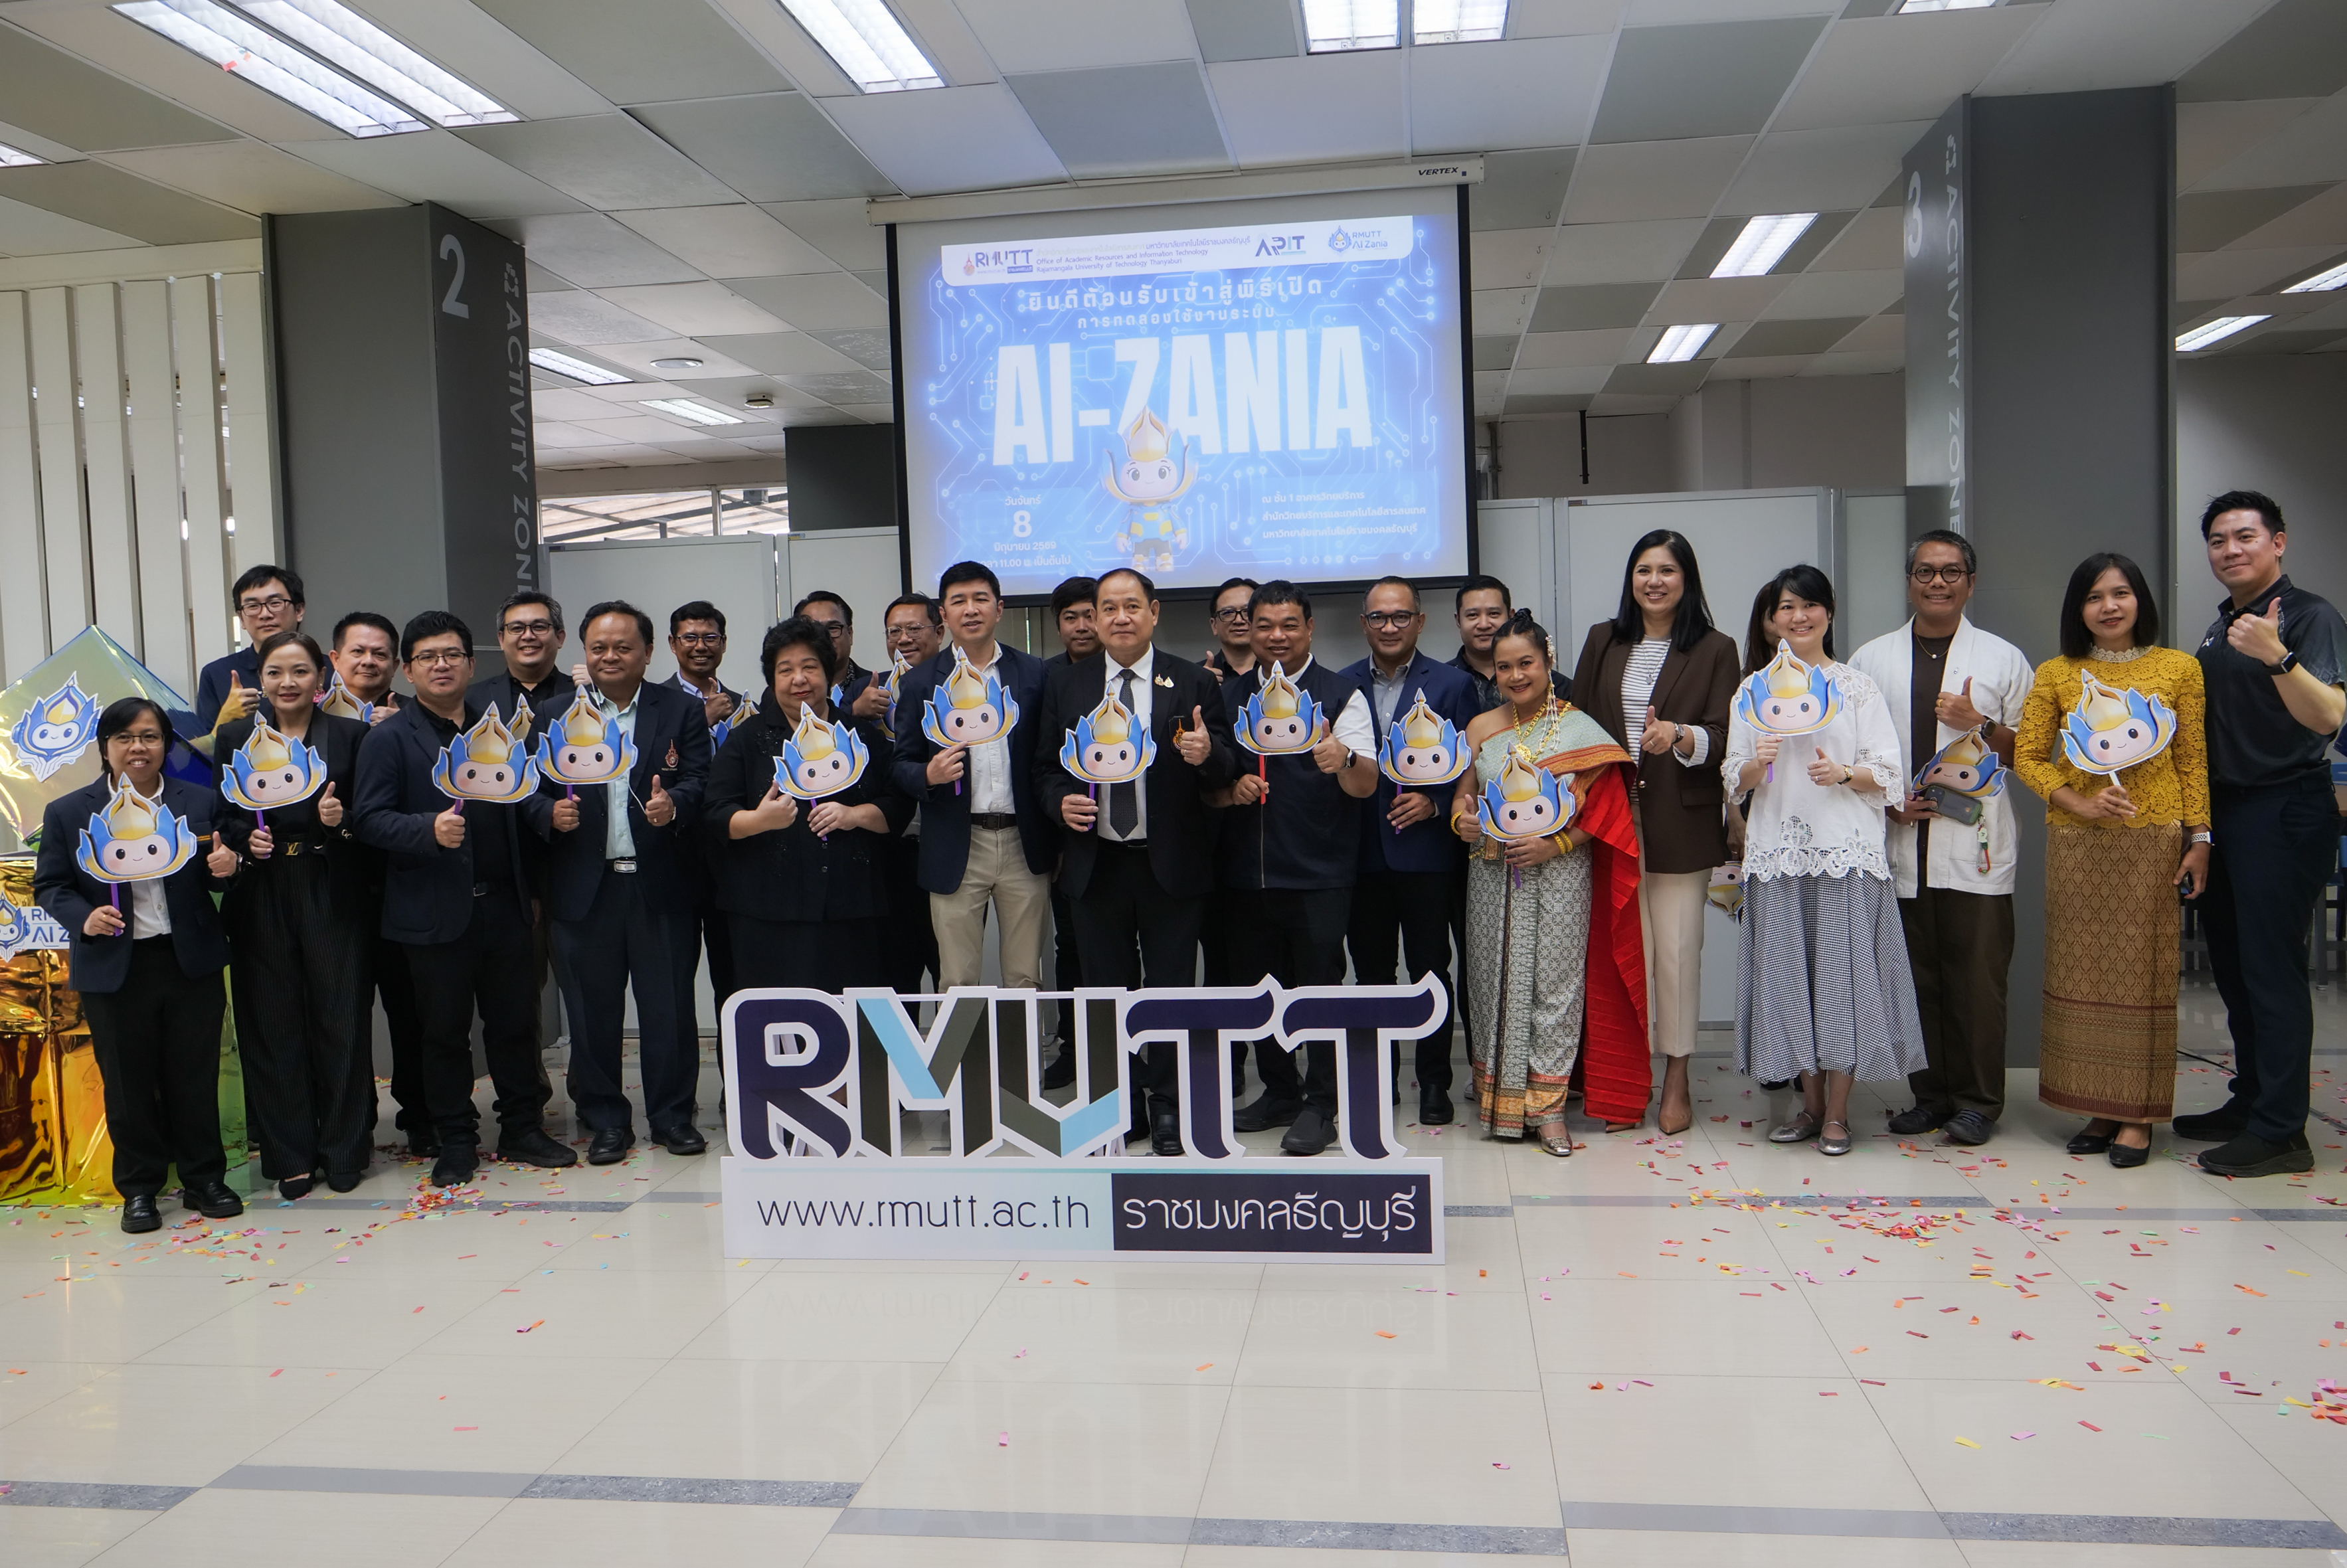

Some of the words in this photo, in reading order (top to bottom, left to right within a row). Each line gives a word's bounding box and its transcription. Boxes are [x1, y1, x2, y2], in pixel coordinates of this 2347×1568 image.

[1419, 167, 1459, 175] VERTEX
[1907, 171, 1923, 258] 3
[1036, 256, 1054, 265] Office
[1365, 239, 1388, 248] Zania
[440, 234, 469, 319] 2
[1037, 264, 1073, 274] Rajamangala
[1115, 260, 1147, 268] Technology
[1029, 276, 1322, 311] ยินดีต้อนรับเข้าสู่พิธีเปิด
[1947, 185, 1959, 389] ACTIVITY
[1078, 306, 1274, 329] การทดลองใช้งานระบบ
[505, 302, 529, 486] ACTIVITY
[993, 325, 1373, 466] AI-ZANIA
[1289, 493, 1294, 502] 1
[1013, 510, 1032, 538] 8
[513, 494, 532, 593] ZON
[1000, 559, 1021, 568] 11.00
[729, 980, 1441, 1160] RMUTT
[757, 1195, 1089, 1229] www.rmutt.ac.th
[1124, 1185, 1417, 1242] ราชมงคลธัญบุรี
